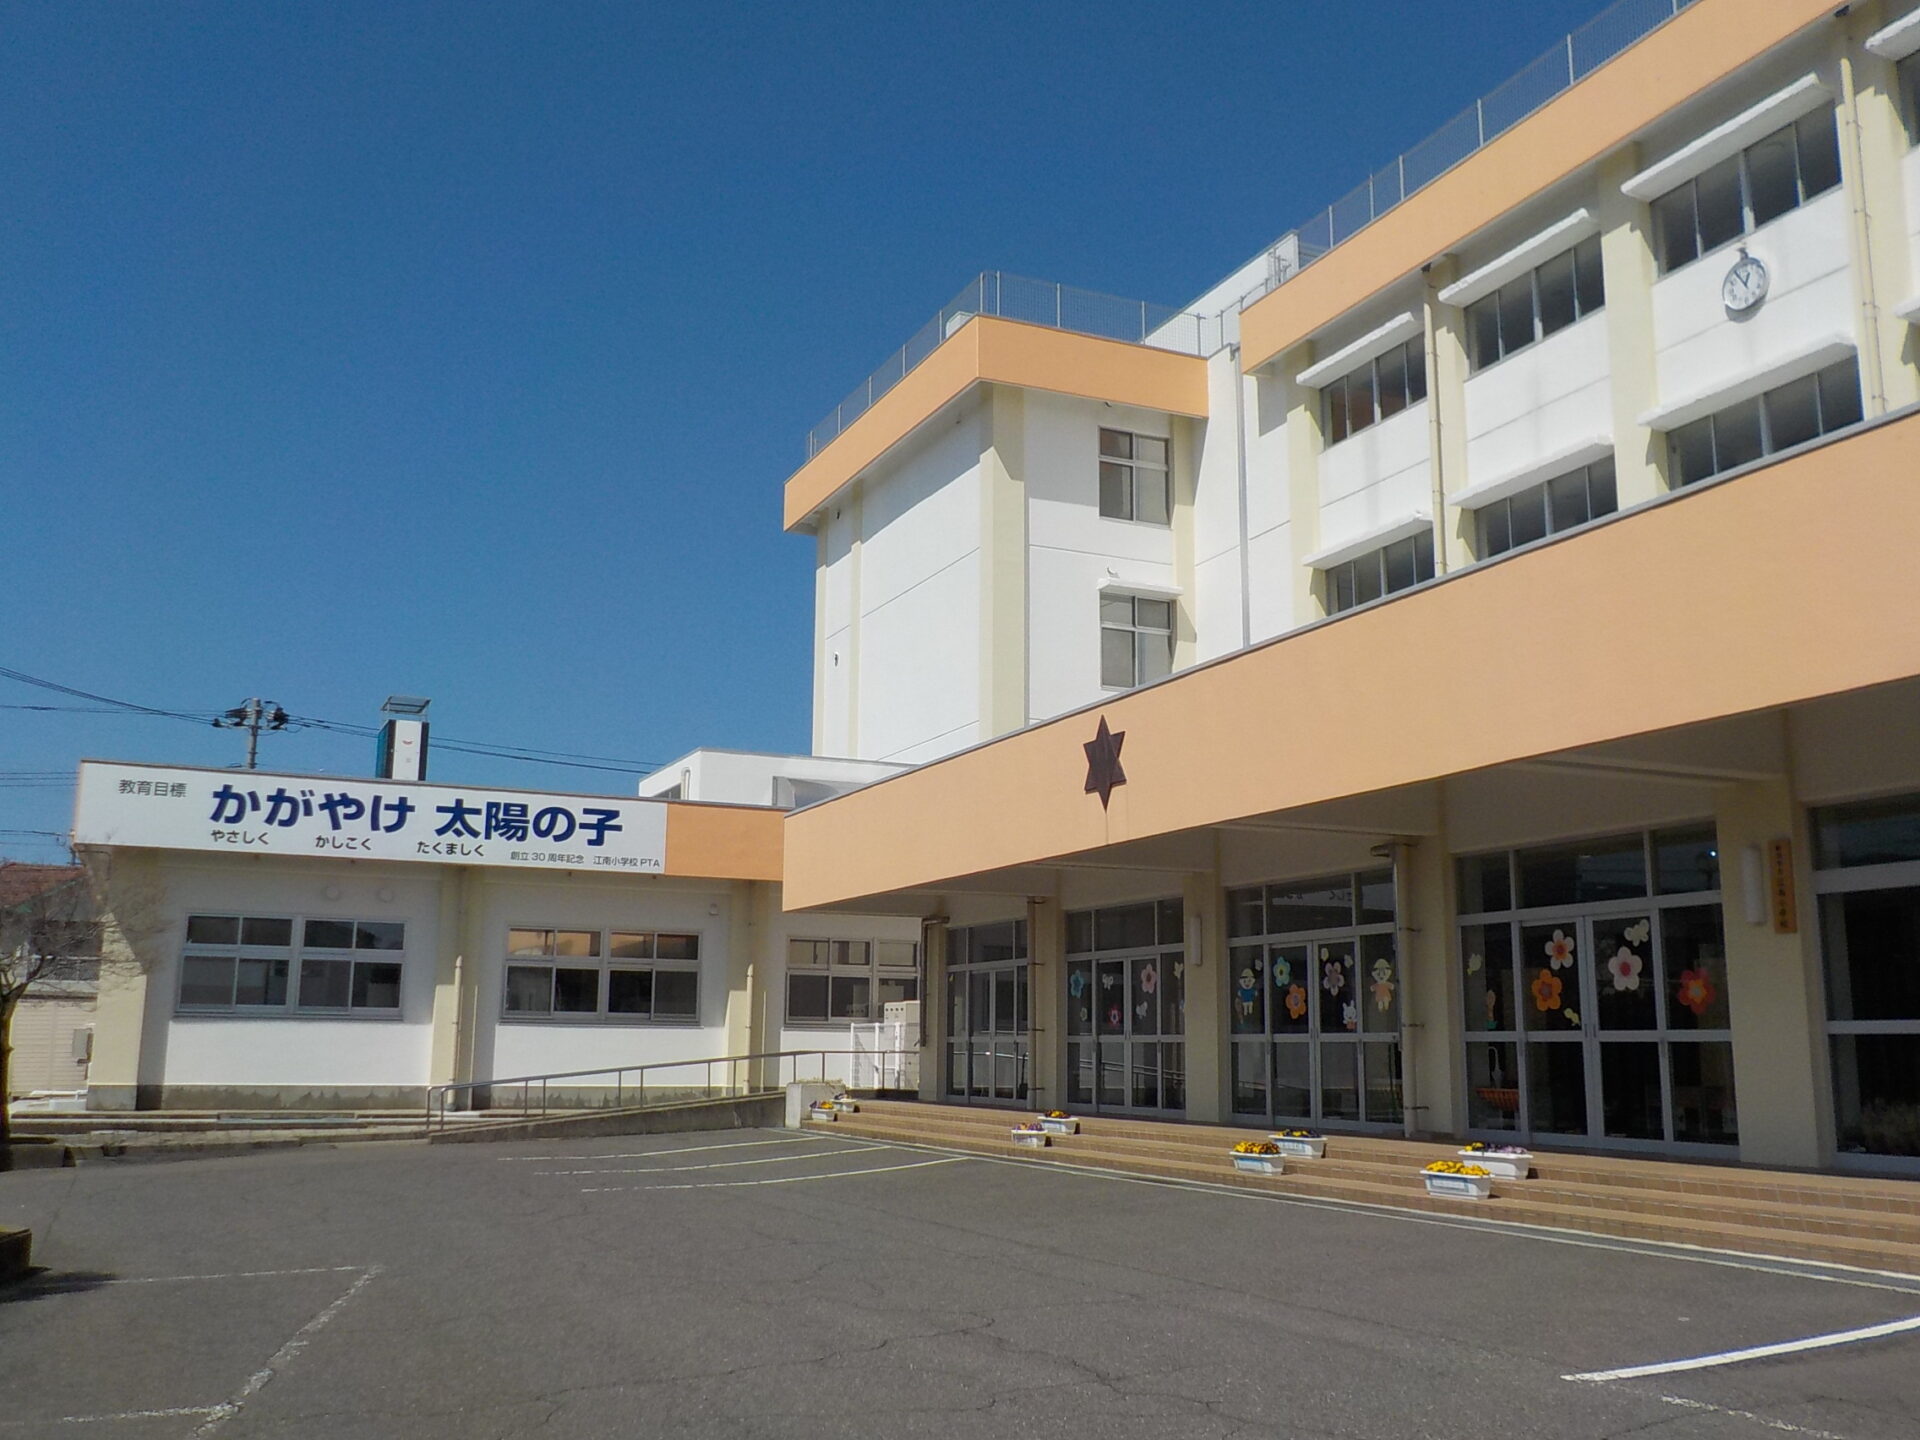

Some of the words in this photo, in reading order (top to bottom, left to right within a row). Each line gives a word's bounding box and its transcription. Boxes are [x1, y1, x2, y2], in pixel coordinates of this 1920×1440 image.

[118, 779, 187, 798] 教育目標
[209, 784, 416, 833] かがやけ
[434, 798, 623, 847] 太陽の子
[210, 829, 270, 845] やさしく
[315, 834, 372, 850] かしこく
[416, 841, 484, 857] たくましく
